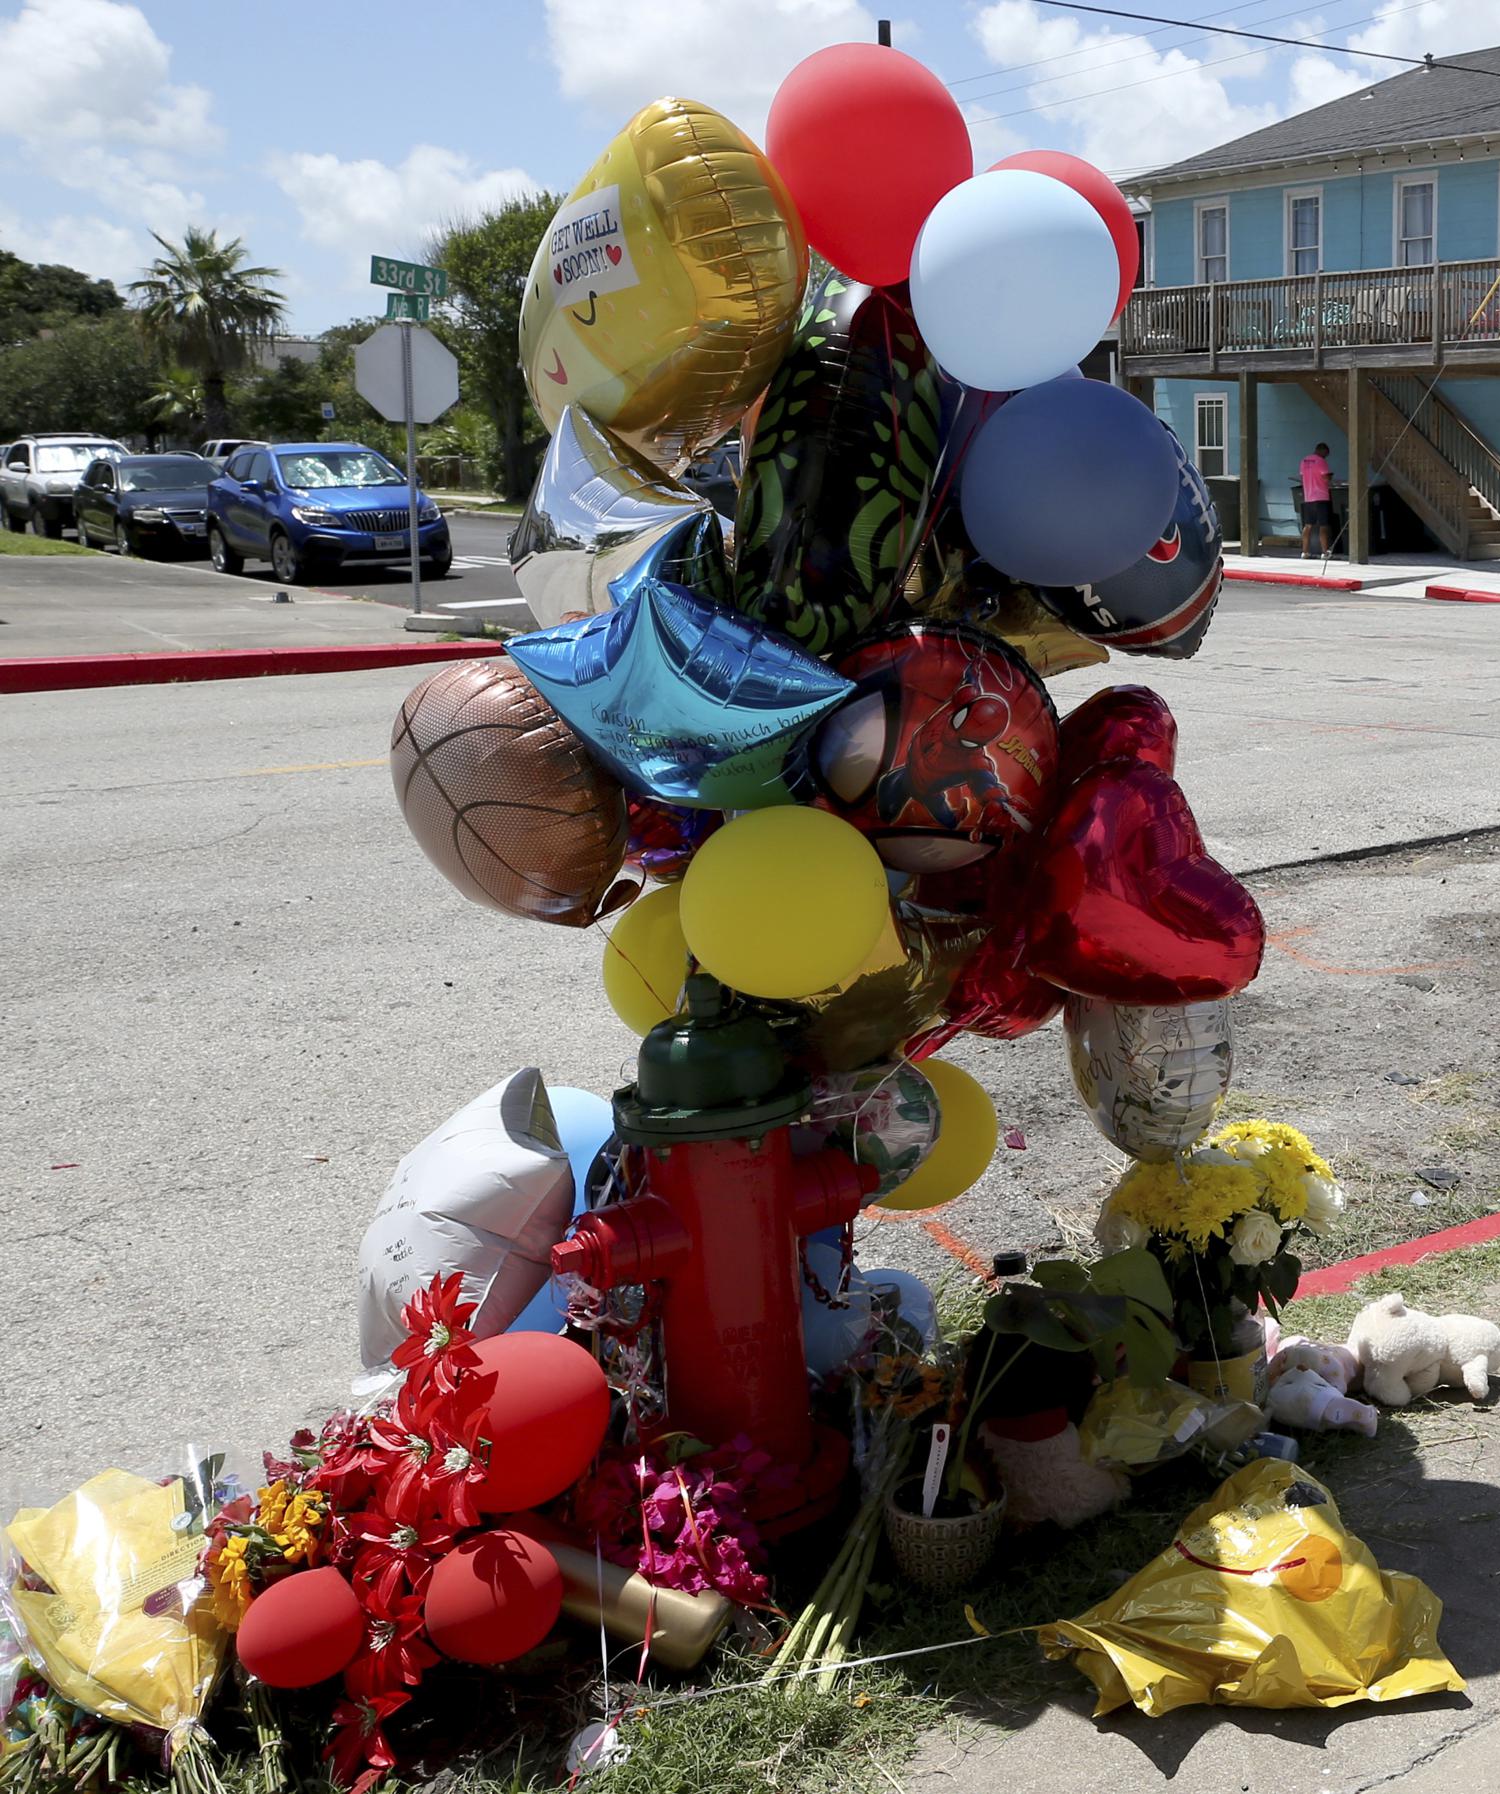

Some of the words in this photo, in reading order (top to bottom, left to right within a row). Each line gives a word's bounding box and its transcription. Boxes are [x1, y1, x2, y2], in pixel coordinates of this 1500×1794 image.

[551, 224, 571, 255] GET
[572, 209, 618, 246] WELL
[377, 261, 415, 288] 33rd
[424, 270, 441, 295] St
[562, 246, 608, 283] SOON!
[392, 298, 409, 318] Ave
[417, 298, 424, 318] R
[721, 723, 772, 743] much
